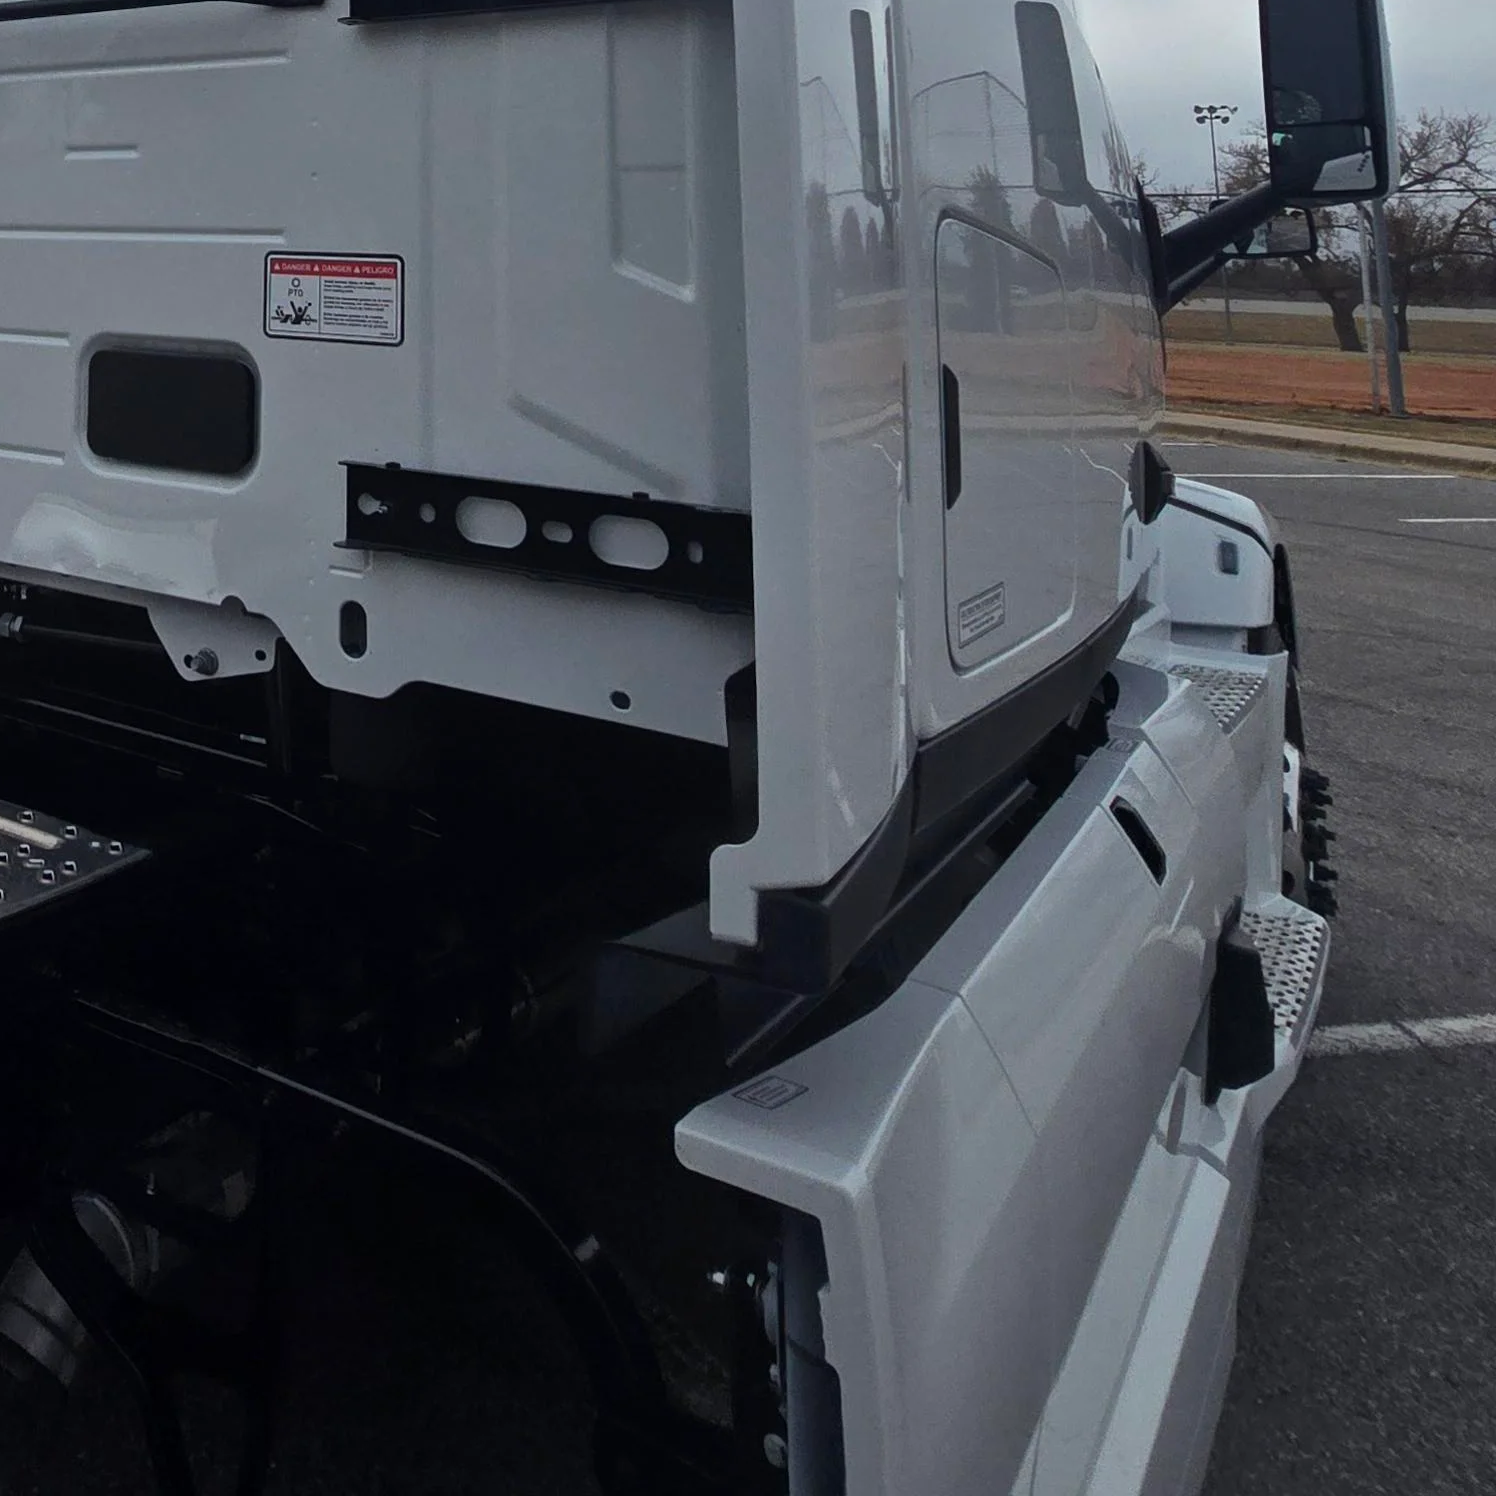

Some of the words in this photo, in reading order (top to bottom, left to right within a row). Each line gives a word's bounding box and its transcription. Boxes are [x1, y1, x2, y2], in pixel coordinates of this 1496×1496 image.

[282, 263, 311, 272] DANGER
[322, 264, 352, 273] DANGER
[361, 266, 394, 274] PELIGRO
[288, 288, 304, 297] PTO
